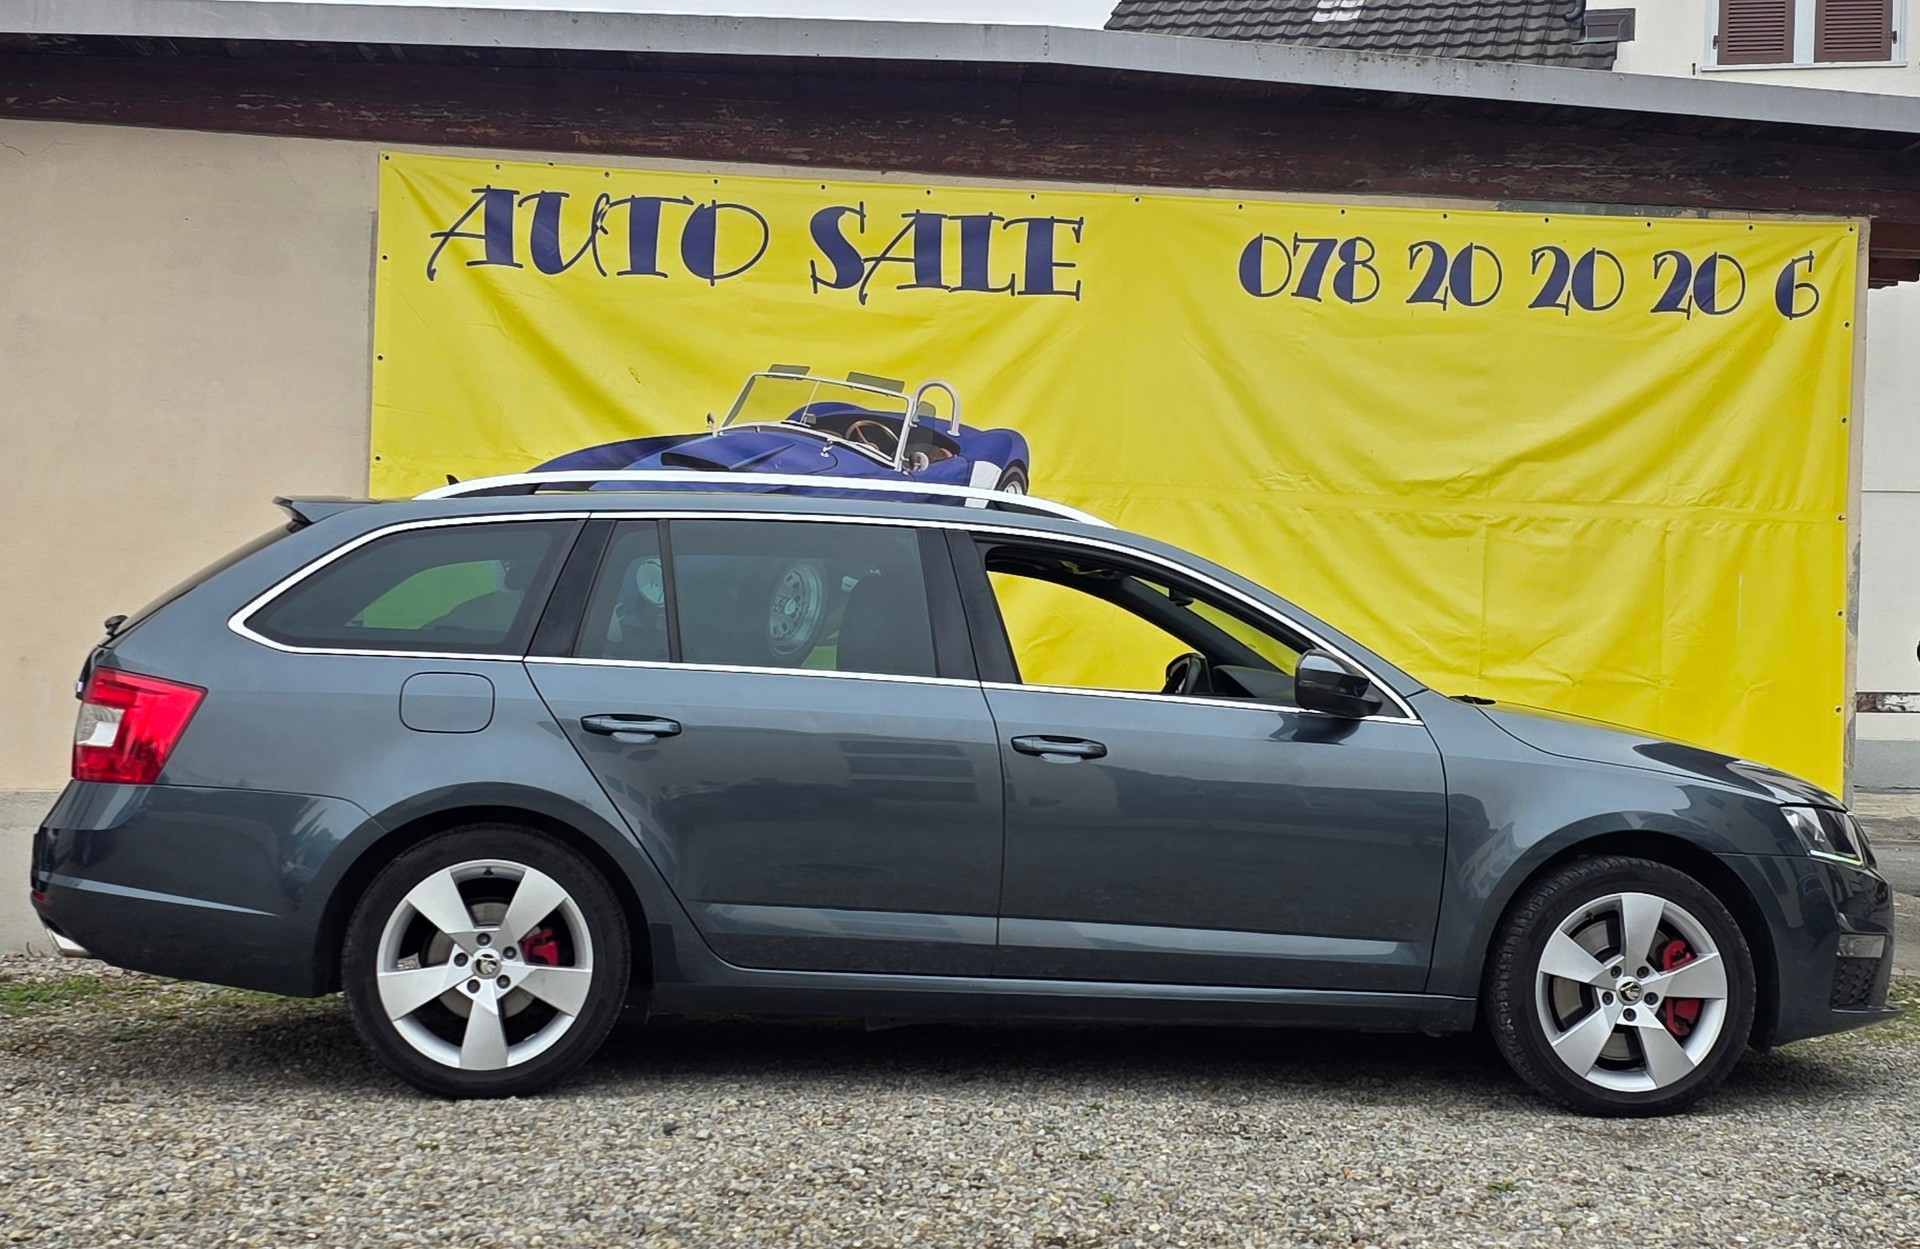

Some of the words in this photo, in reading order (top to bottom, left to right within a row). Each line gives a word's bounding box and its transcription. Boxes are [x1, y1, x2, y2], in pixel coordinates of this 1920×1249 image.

[426, 185, 770, 288] AUTO
[809, 201, 1085, 305] SALE
[1239, 233, 1382, 305] 078
[1406, 240, 1503, 311] 20
[1528, 246, 1625, 316] 20
[1651, 251, 1746, 320] 20
[1774, 250, 1820, 320] 6
